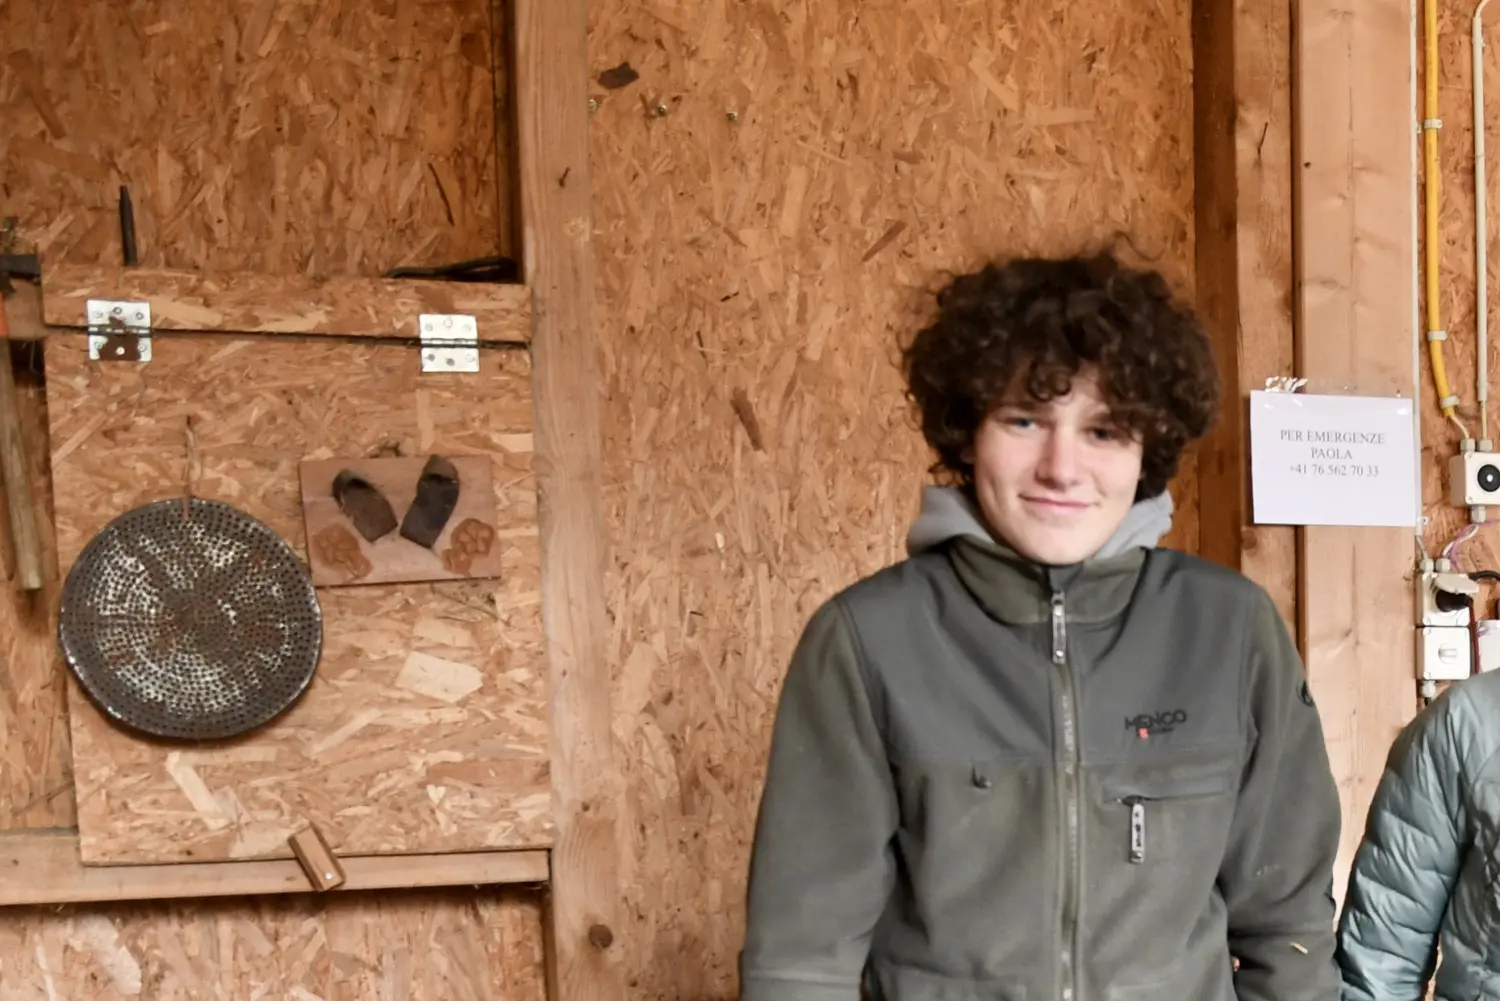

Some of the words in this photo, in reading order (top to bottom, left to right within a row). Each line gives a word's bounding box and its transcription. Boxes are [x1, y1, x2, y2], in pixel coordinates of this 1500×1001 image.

[1280, 429, 1303, 442] PER
[1307, 430, 1386, 445] EMERGENZE
[1310, 447, 1353, 460] PAOLA
[1289, 463, 1307, 475] +41
[1311, 464, 1325, 476] 76
[1328, 464, 1347, 476] 562
[1351, 465, 1364, 477] 70
[1366, 466, 1380, 478] 33
